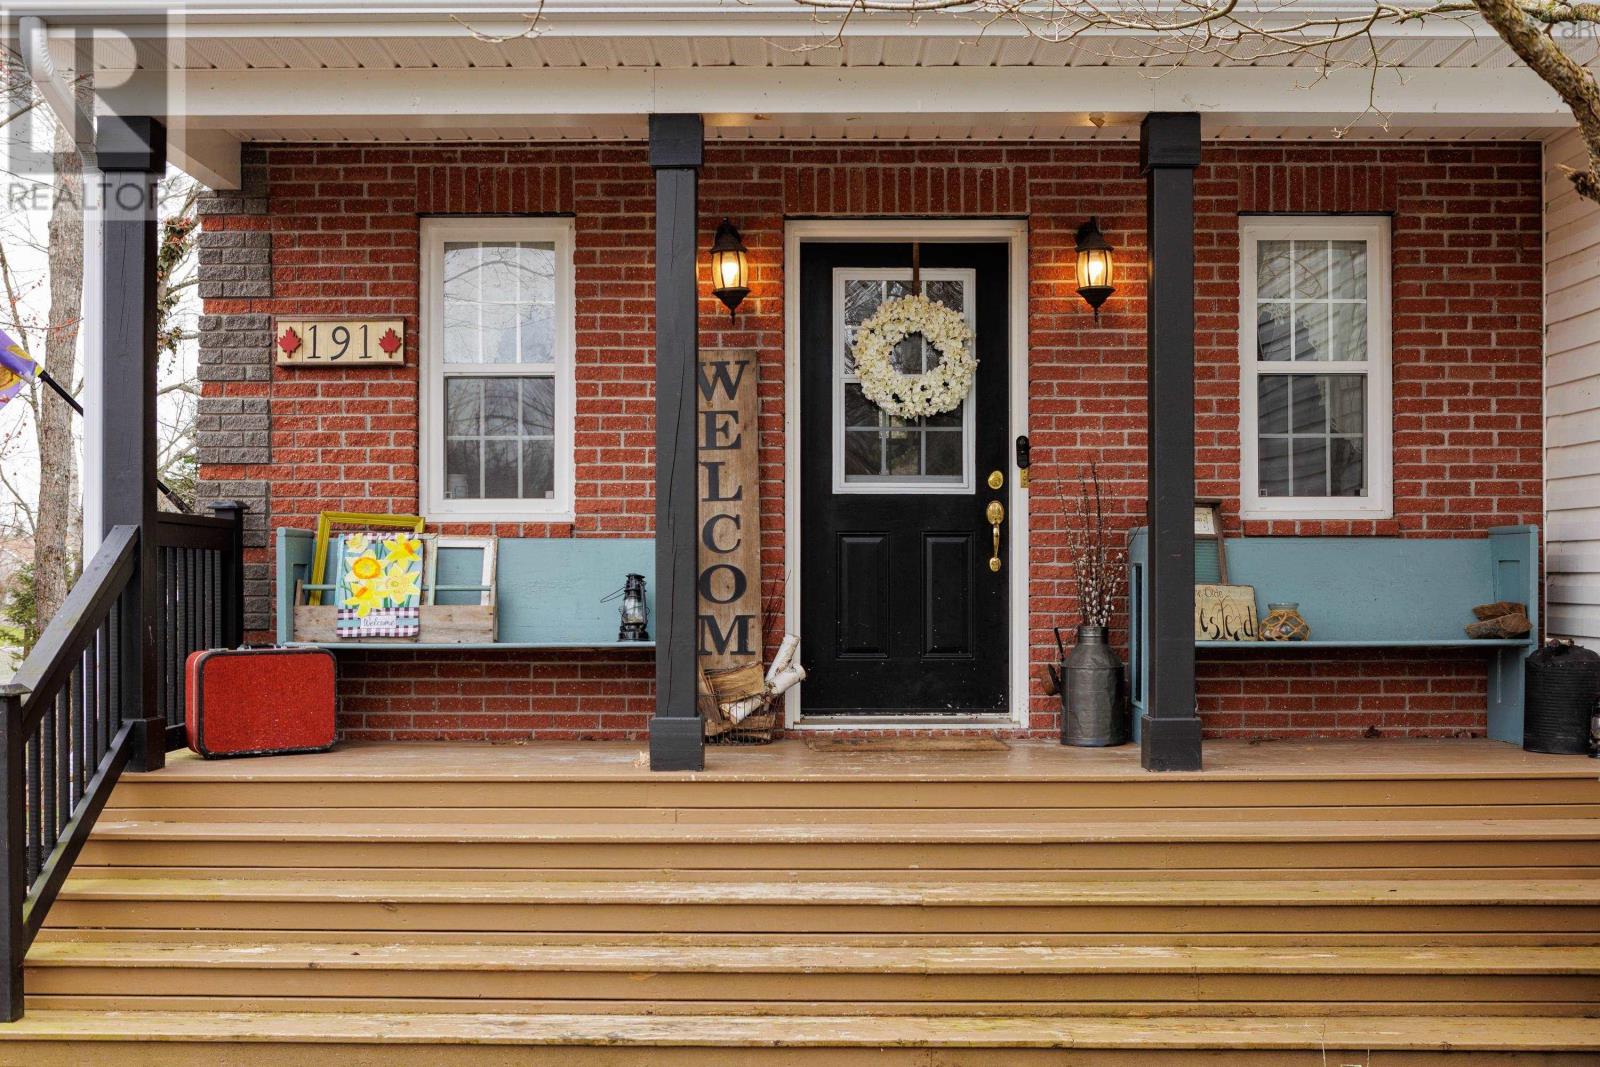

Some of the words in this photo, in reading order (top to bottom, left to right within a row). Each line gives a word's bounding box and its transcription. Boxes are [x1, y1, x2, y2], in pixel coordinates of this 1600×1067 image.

[307, 324, 372, 361] 191
[697, 360, 756, 656] WELCOM
[362, 616, 395, 627] Welcome
